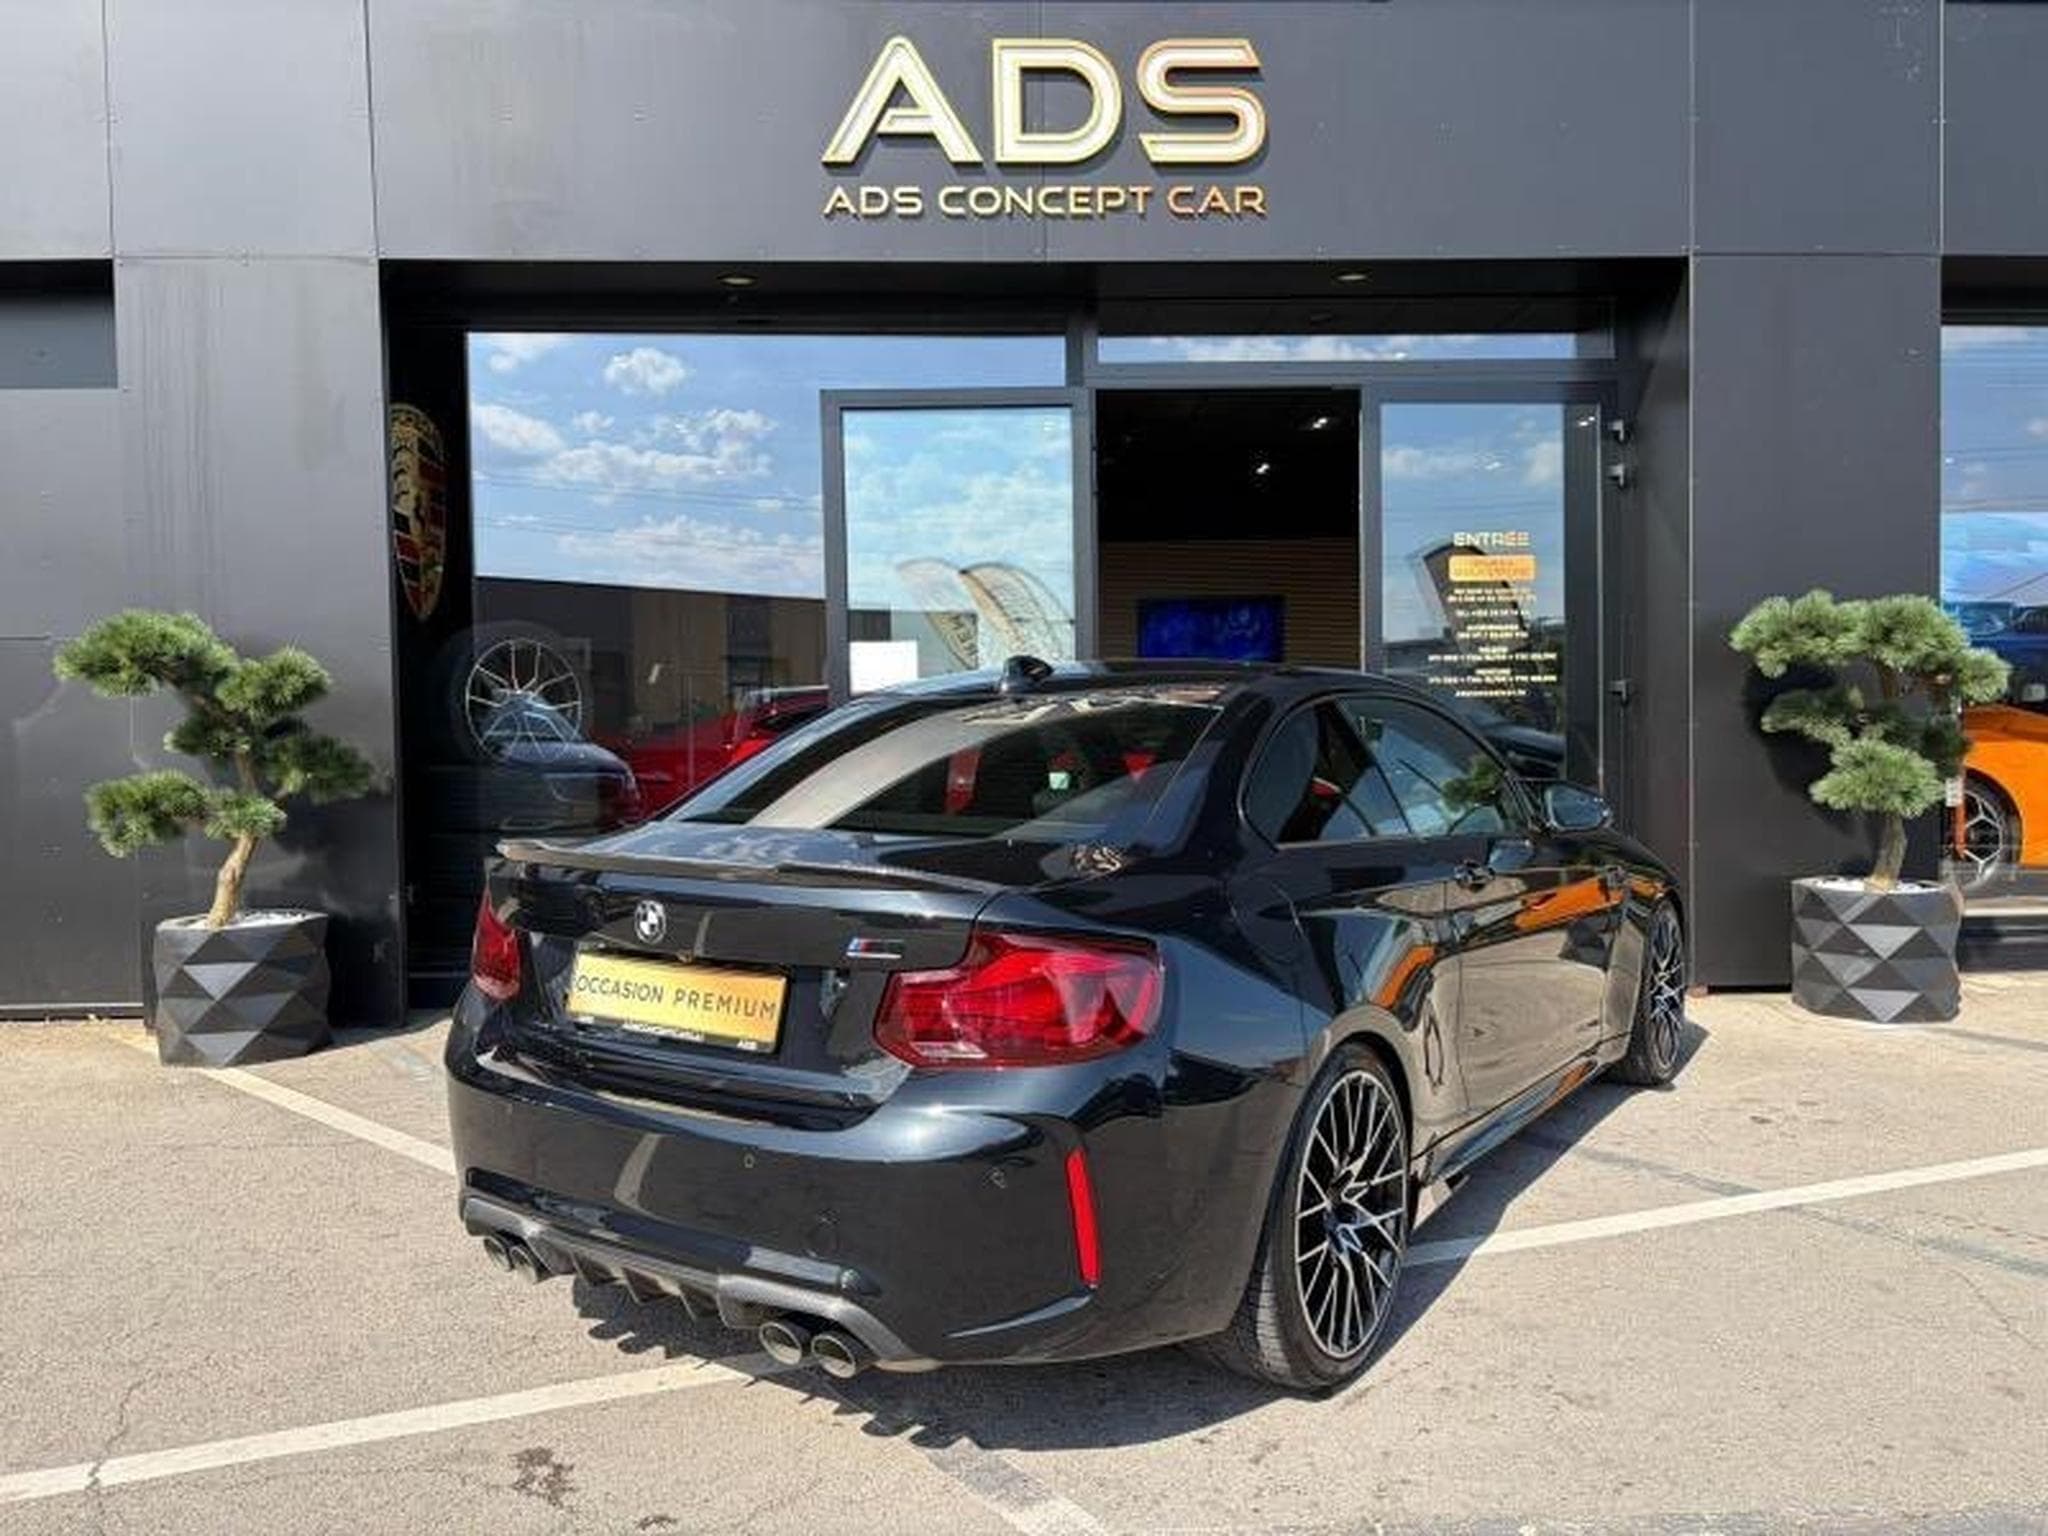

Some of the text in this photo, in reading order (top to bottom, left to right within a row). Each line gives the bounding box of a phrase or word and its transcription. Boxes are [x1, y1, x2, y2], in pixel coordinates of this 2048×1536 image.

[821, 35, 1268, 164] ADS
[823, 185, 1267, 216] ADS CONCEPT CAR
[575, 974, 777, 1021] OCCASION PREMIUM
